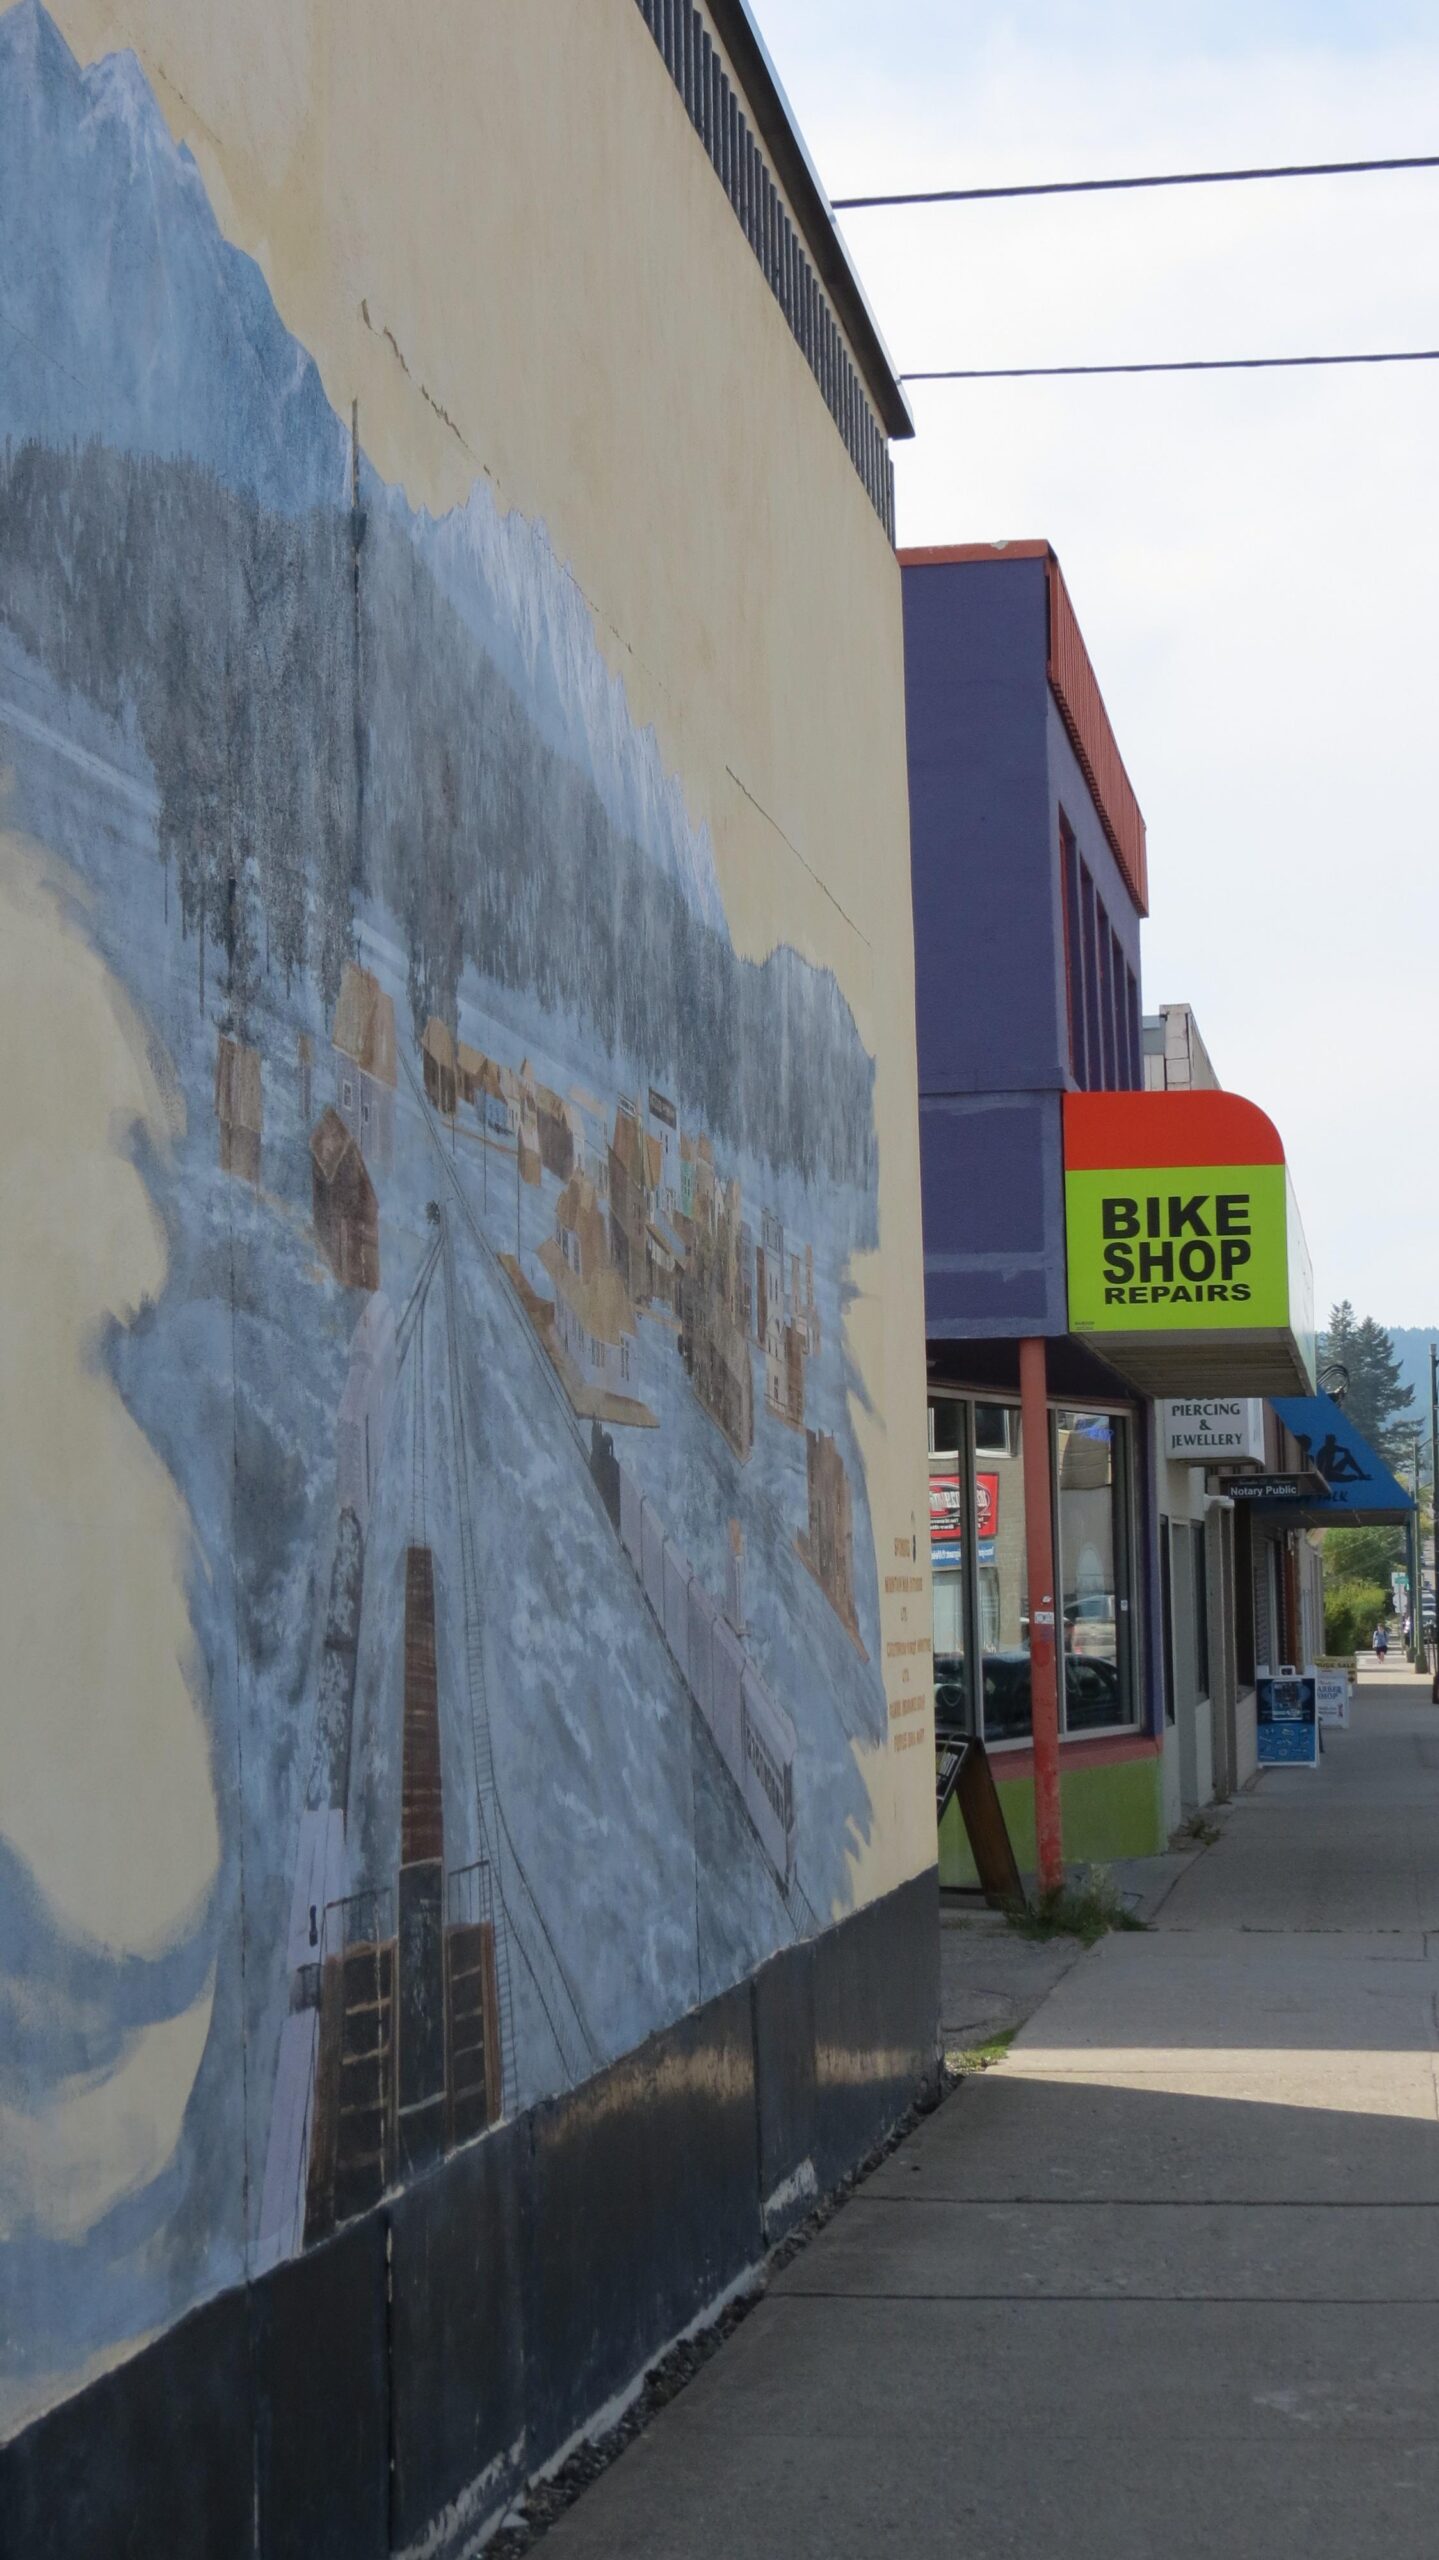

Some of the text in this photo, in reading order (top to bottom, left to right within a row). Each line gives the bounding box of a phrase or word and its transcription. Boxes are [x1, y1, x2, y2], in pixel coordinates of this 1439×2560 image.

[1102, 1194, 1251, 1239] BIKE
[1103, 1239, 1251, 1284] SHOP
[1104, 1283, 1251, 1305] REPAIRS
[1171, 1403, 1241, 1416] PIERCING
[1199, 1418, 1212, 1431] &
[1171, 1433, 1242, 1448] JEWELLERY
[1230, 1485, 1297, 1497] Notary Public
